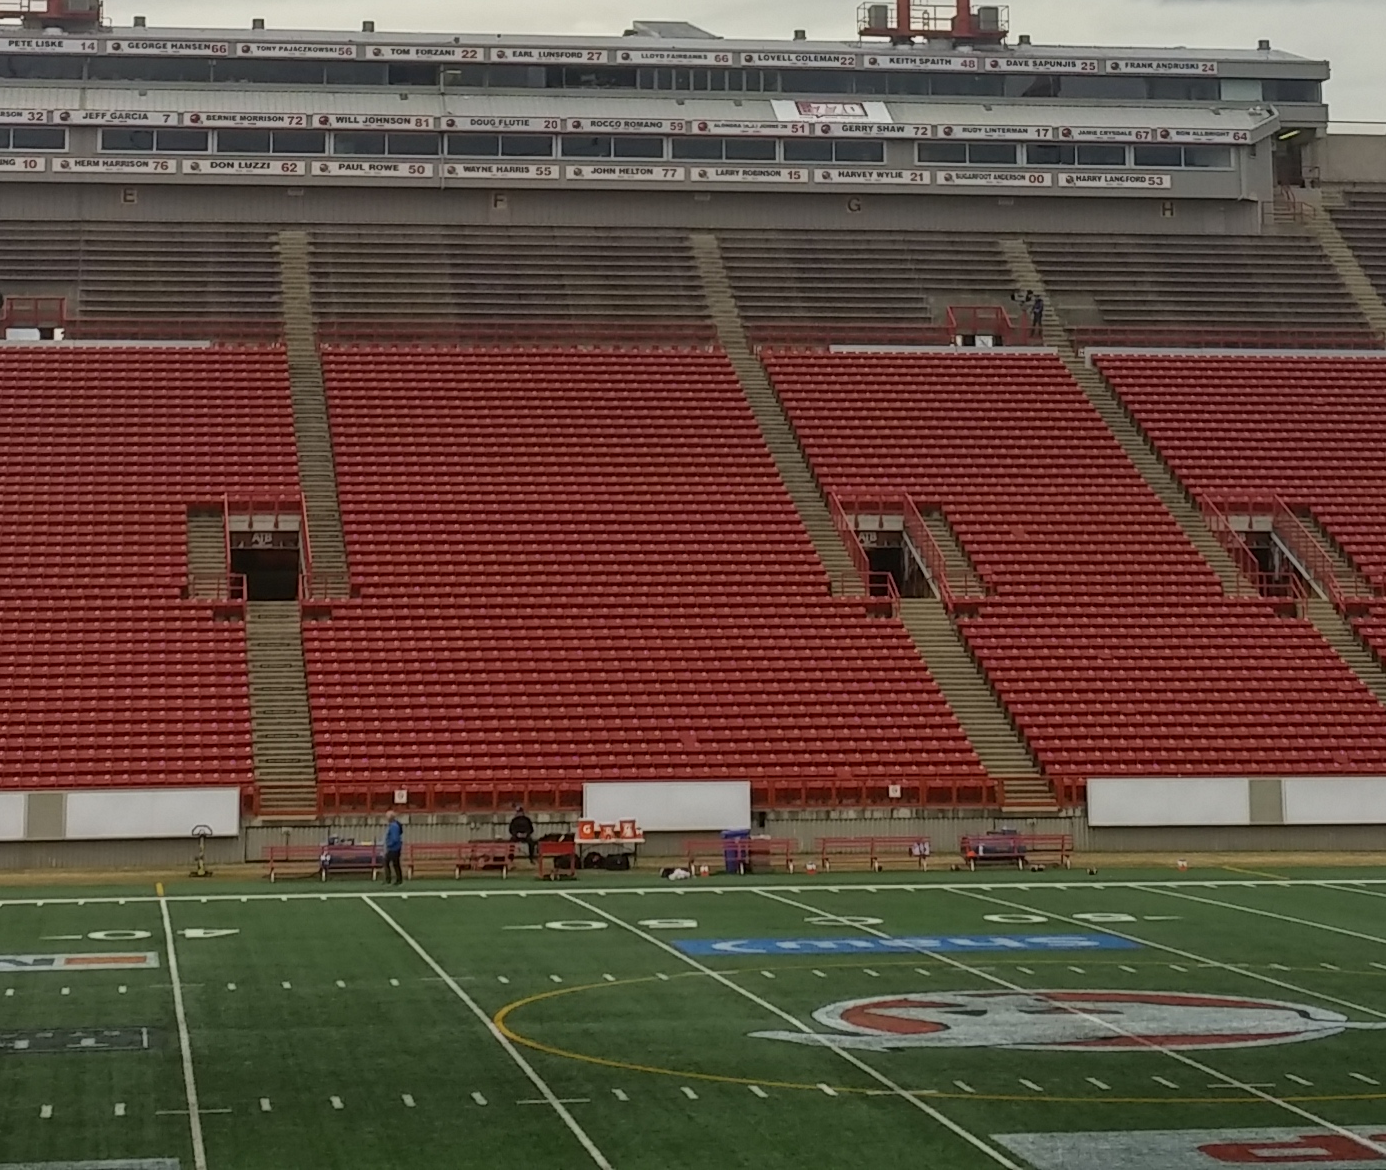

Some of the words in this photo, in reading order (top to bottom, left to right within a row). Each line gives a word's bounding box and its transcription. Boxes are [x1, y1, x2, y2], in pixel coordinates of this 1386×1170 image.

[81, 42, 95, 50] 14
[128, 42, 168, 50] GEORGE
[211, 44, 227, 53] 66
[338, 47, 353, 56] 56
[391, 48, 411, 56] TOM
[461, 49, 478, 59] 22
[538, 51, 583, 59] LUNSFORD
[587, 52, 602, 61] 27
[714, 54, 729, 63] 66
[758, 54, 793, 62] LOVELL
[840, 57, 855, 66] 22
[889, 57, 917, 65] KEITH
[960, 59, 975, 68] 48
[1032, 60, 1077, 68] SAPUNJIS
[1081, 62, 1096, 71] 25
[1202, 64, 1214, 72] 24
[27, 112, 44, 121] 32
[82, 112, 107, 120] JEFF
[110, 112, 149, 120] GARCIA
[162, 114, 171, 123] 7
[287, 116, 303, 125] 72
[335, 116, 359, 124] WILL
[362, 117, 411, 125] JOHNSON
[415, 118, 430, 128] 81
[498, 119, 530, 127] FLUTIE
[543, 120, 558, 129] 20
[623, 121, 663, 129] ROMANO
[669, 122, 683, 131] 59
[791, 124, 805, 133] 51
[876, 125, 905, 133] SHAW
[913, 126, 928, 136] 72
[1035, 128, 1049, 138] 17
[1135, 131, 1149, 140] 67
[1233, 132, 1247, 141] 64
[22, 160, 38, 169] 10
[102, 160, 149, 168] HARRISON
[152, 161, 169, 170] 76
[210, 161, 235, 169] DON
[238, 161, 271, 170] LUZZI
[281, 163, 298, 173] 62
[408, 165, 425, 175] 50
[463, 165, 493, 173] WAYNE
[496, 166, 530, 174] HARRIS
[535, 167, 552, 176] 55
[591, 167, 616, 175] JOHN
[662, 169, 677, 178] 77
[787, 171, 801, 180] 15
[838, 170, 873, 178] HARVEY
[876, 171, 903, 179] WYLIE
[910, 172, 924, 182] 21
[993, 173, 1026, 181] ANDERSON
[1029, 174, 1044, 184] 00
[1104, 175, 1147, 183] LANGFORD
[1147, 176, 1164, 186] 53
[123, 189, 135, 203] E
[493, 194, 505, 208] F
[847, 197, 861, 212] G
[1162, 202, 1173, 216] H
[775, 935, 1101, 950] shaw
